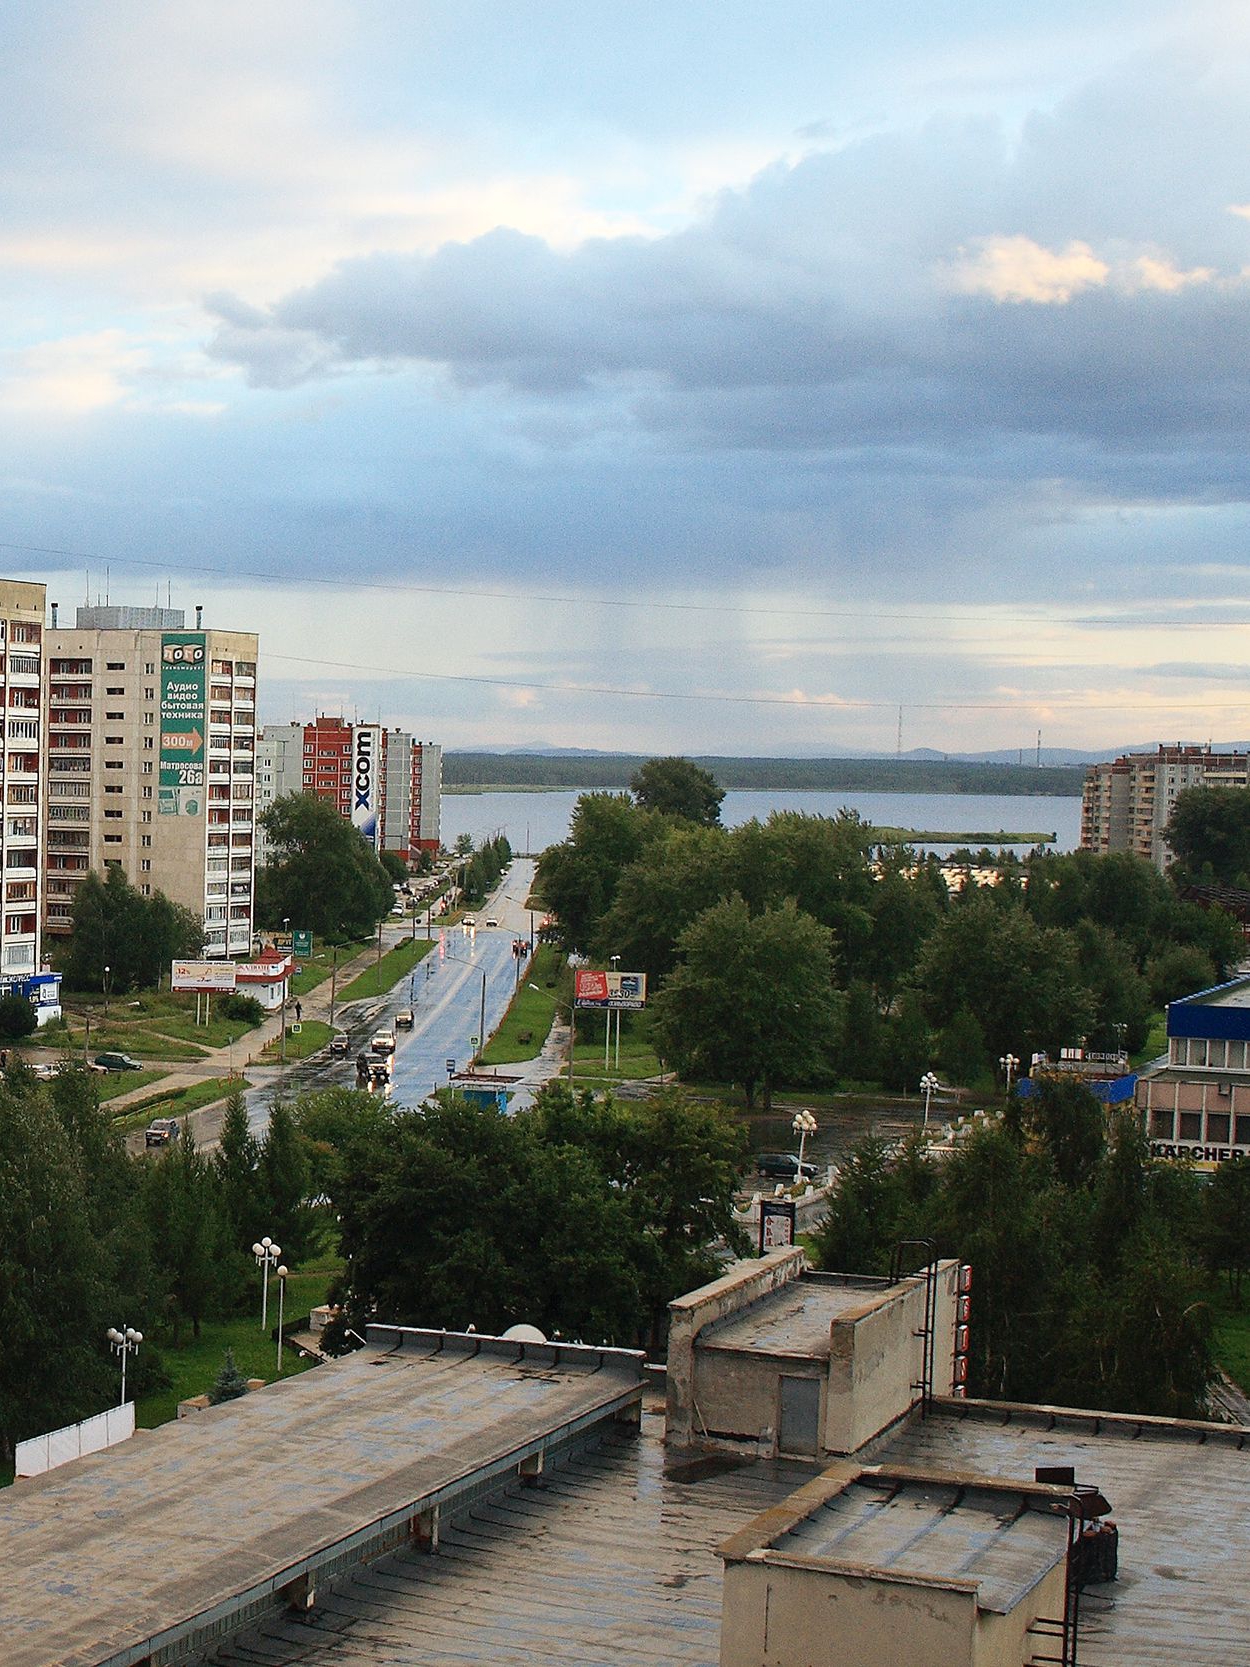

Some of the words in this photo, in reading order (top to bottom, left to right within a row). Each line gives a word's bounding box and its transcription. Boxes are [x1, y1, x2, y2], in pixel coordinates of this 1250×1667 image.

[167, 682, 198, 692] Аудио
[167, 693, 198, 701] видео
[161, 701, 204, 710] бытовая
[163, 736, 186, 747] 300
[160, 761, 203, 770] Матросова
[178, 770, 203, 784] 26а
